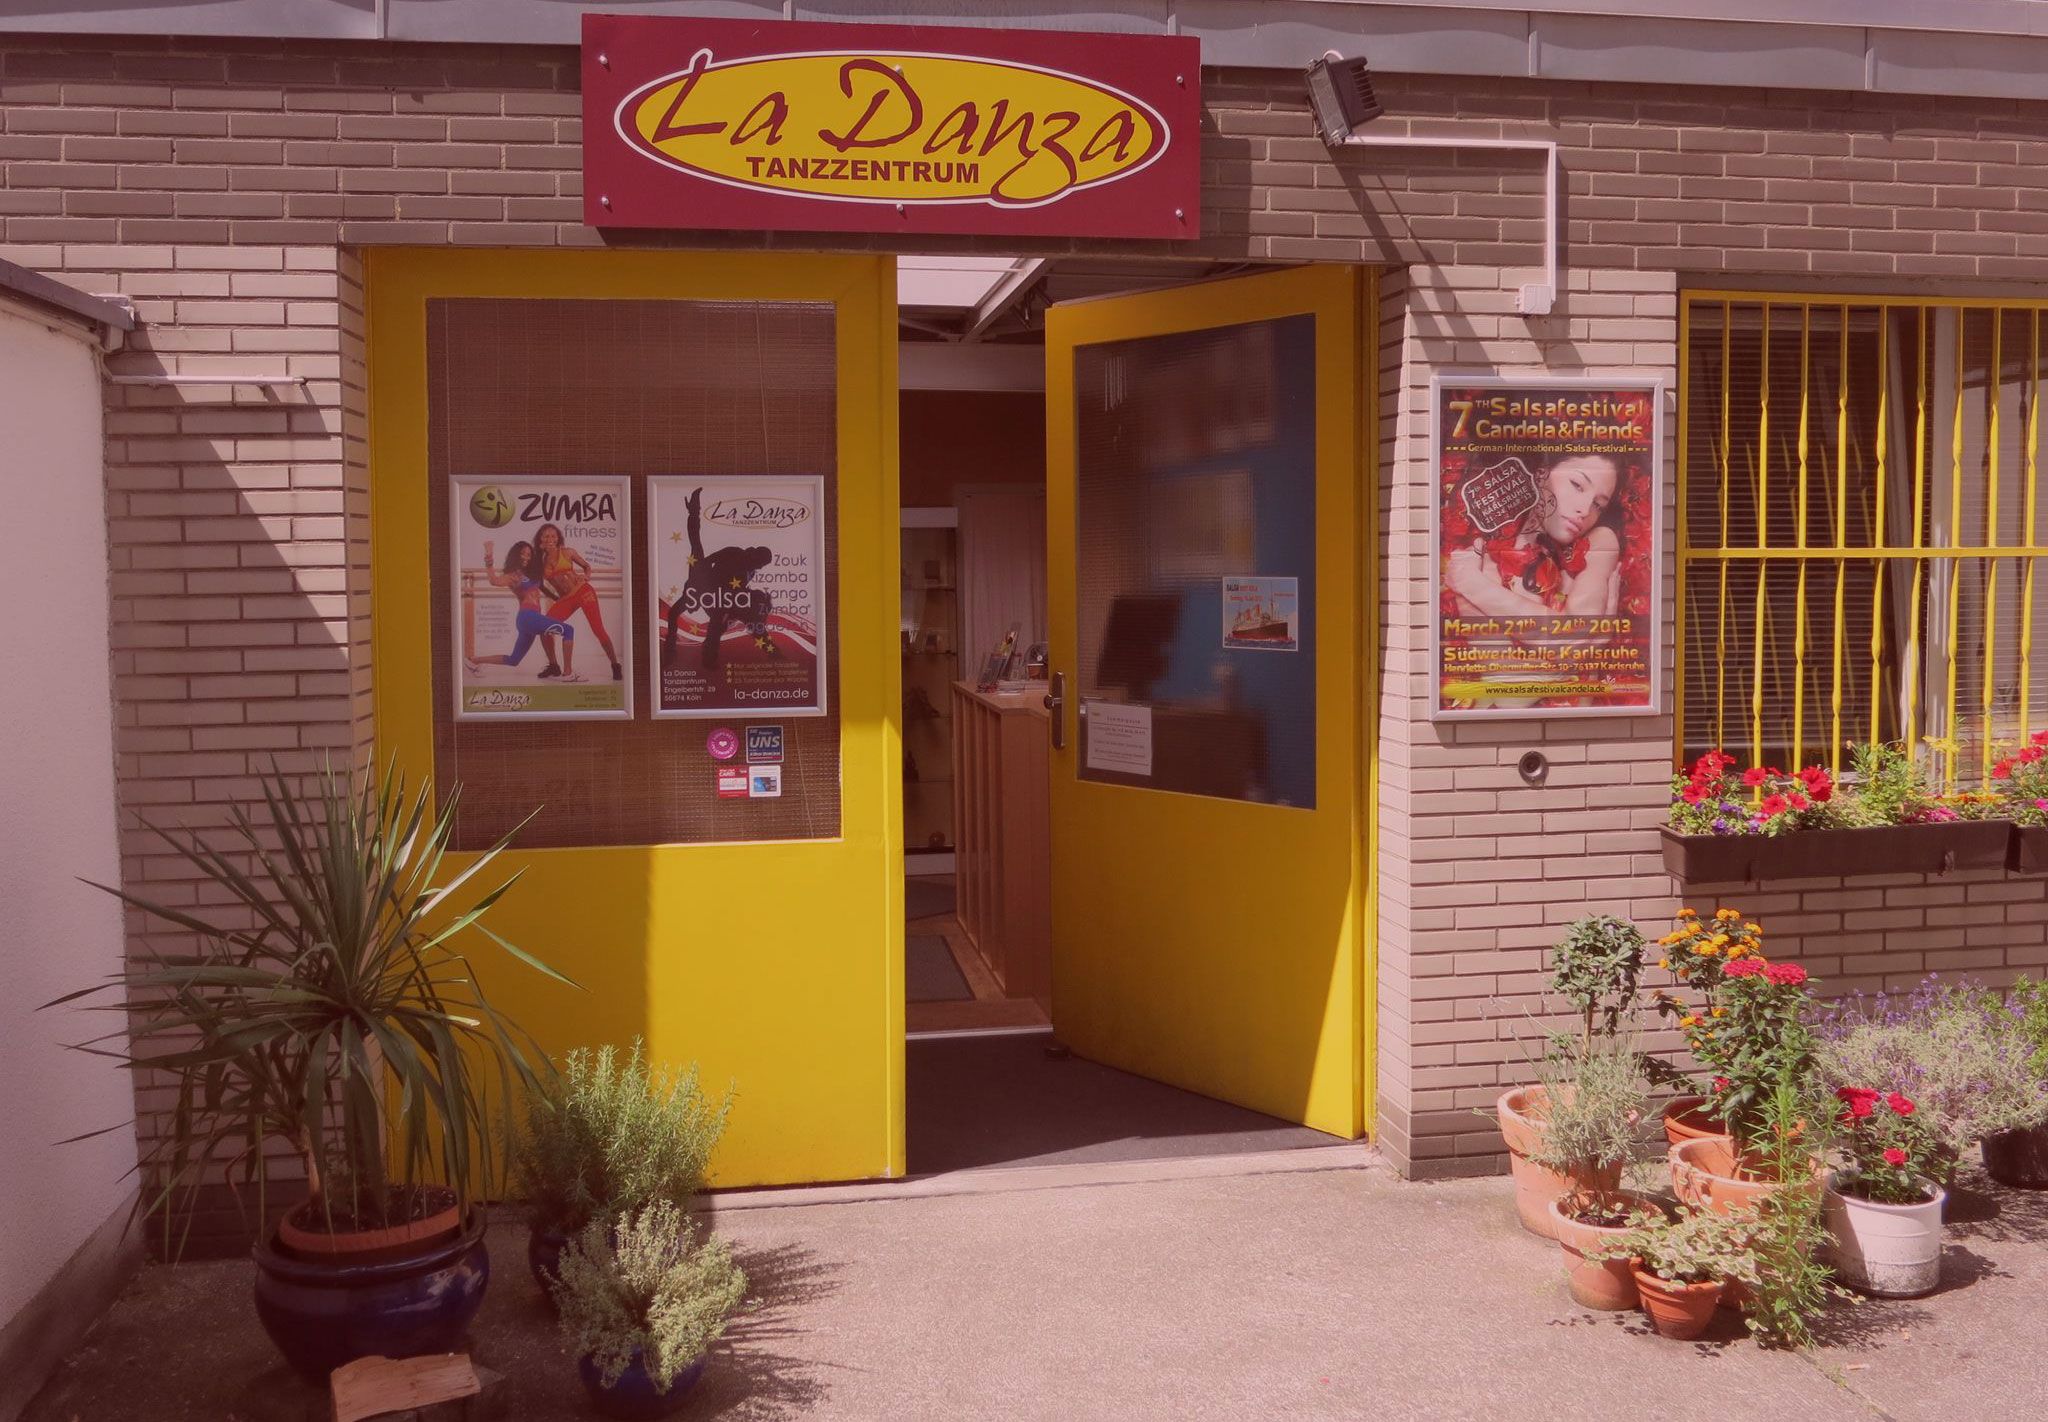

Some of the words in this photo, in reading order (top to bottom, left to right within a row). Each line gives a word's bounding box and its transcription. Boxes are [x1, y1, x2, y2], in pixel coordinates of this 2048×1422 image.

[652, 52, 790, 147] La
[818, 58, 1137, 200] Danza
[745, 155, 980, 184] TANZZENTRUM
[1491, 397, 1645, 417] Salsafestival
[1484, 466, 1517, 490] SALSA
[1475, 477, 1526, 509] FESTIVAL
[1482, 486, 1529, 517] KARLSRUHE
[518, 492, 617, 523] ZUMBA
[711, 500, 737, 520] La
[742, 500, 807, 529] Danza
[564, 526, 617, 539] fitness
[774, 553, 807, 567] Zouk
[684, 586, 752, 610] Salsa
[1444, 618, 1499, 636] March
[1590, 618, 1632, 634] 2013
[1444, 645, 1556, 662] Südwerkhalle
[1560, 645, 1639, 661] Karlsruhe
[1600, 662, 1645, 671] Karlsruhe
[734, 687, 809, 700] la-danza.de
[750, 735, 781, 748] UNS
